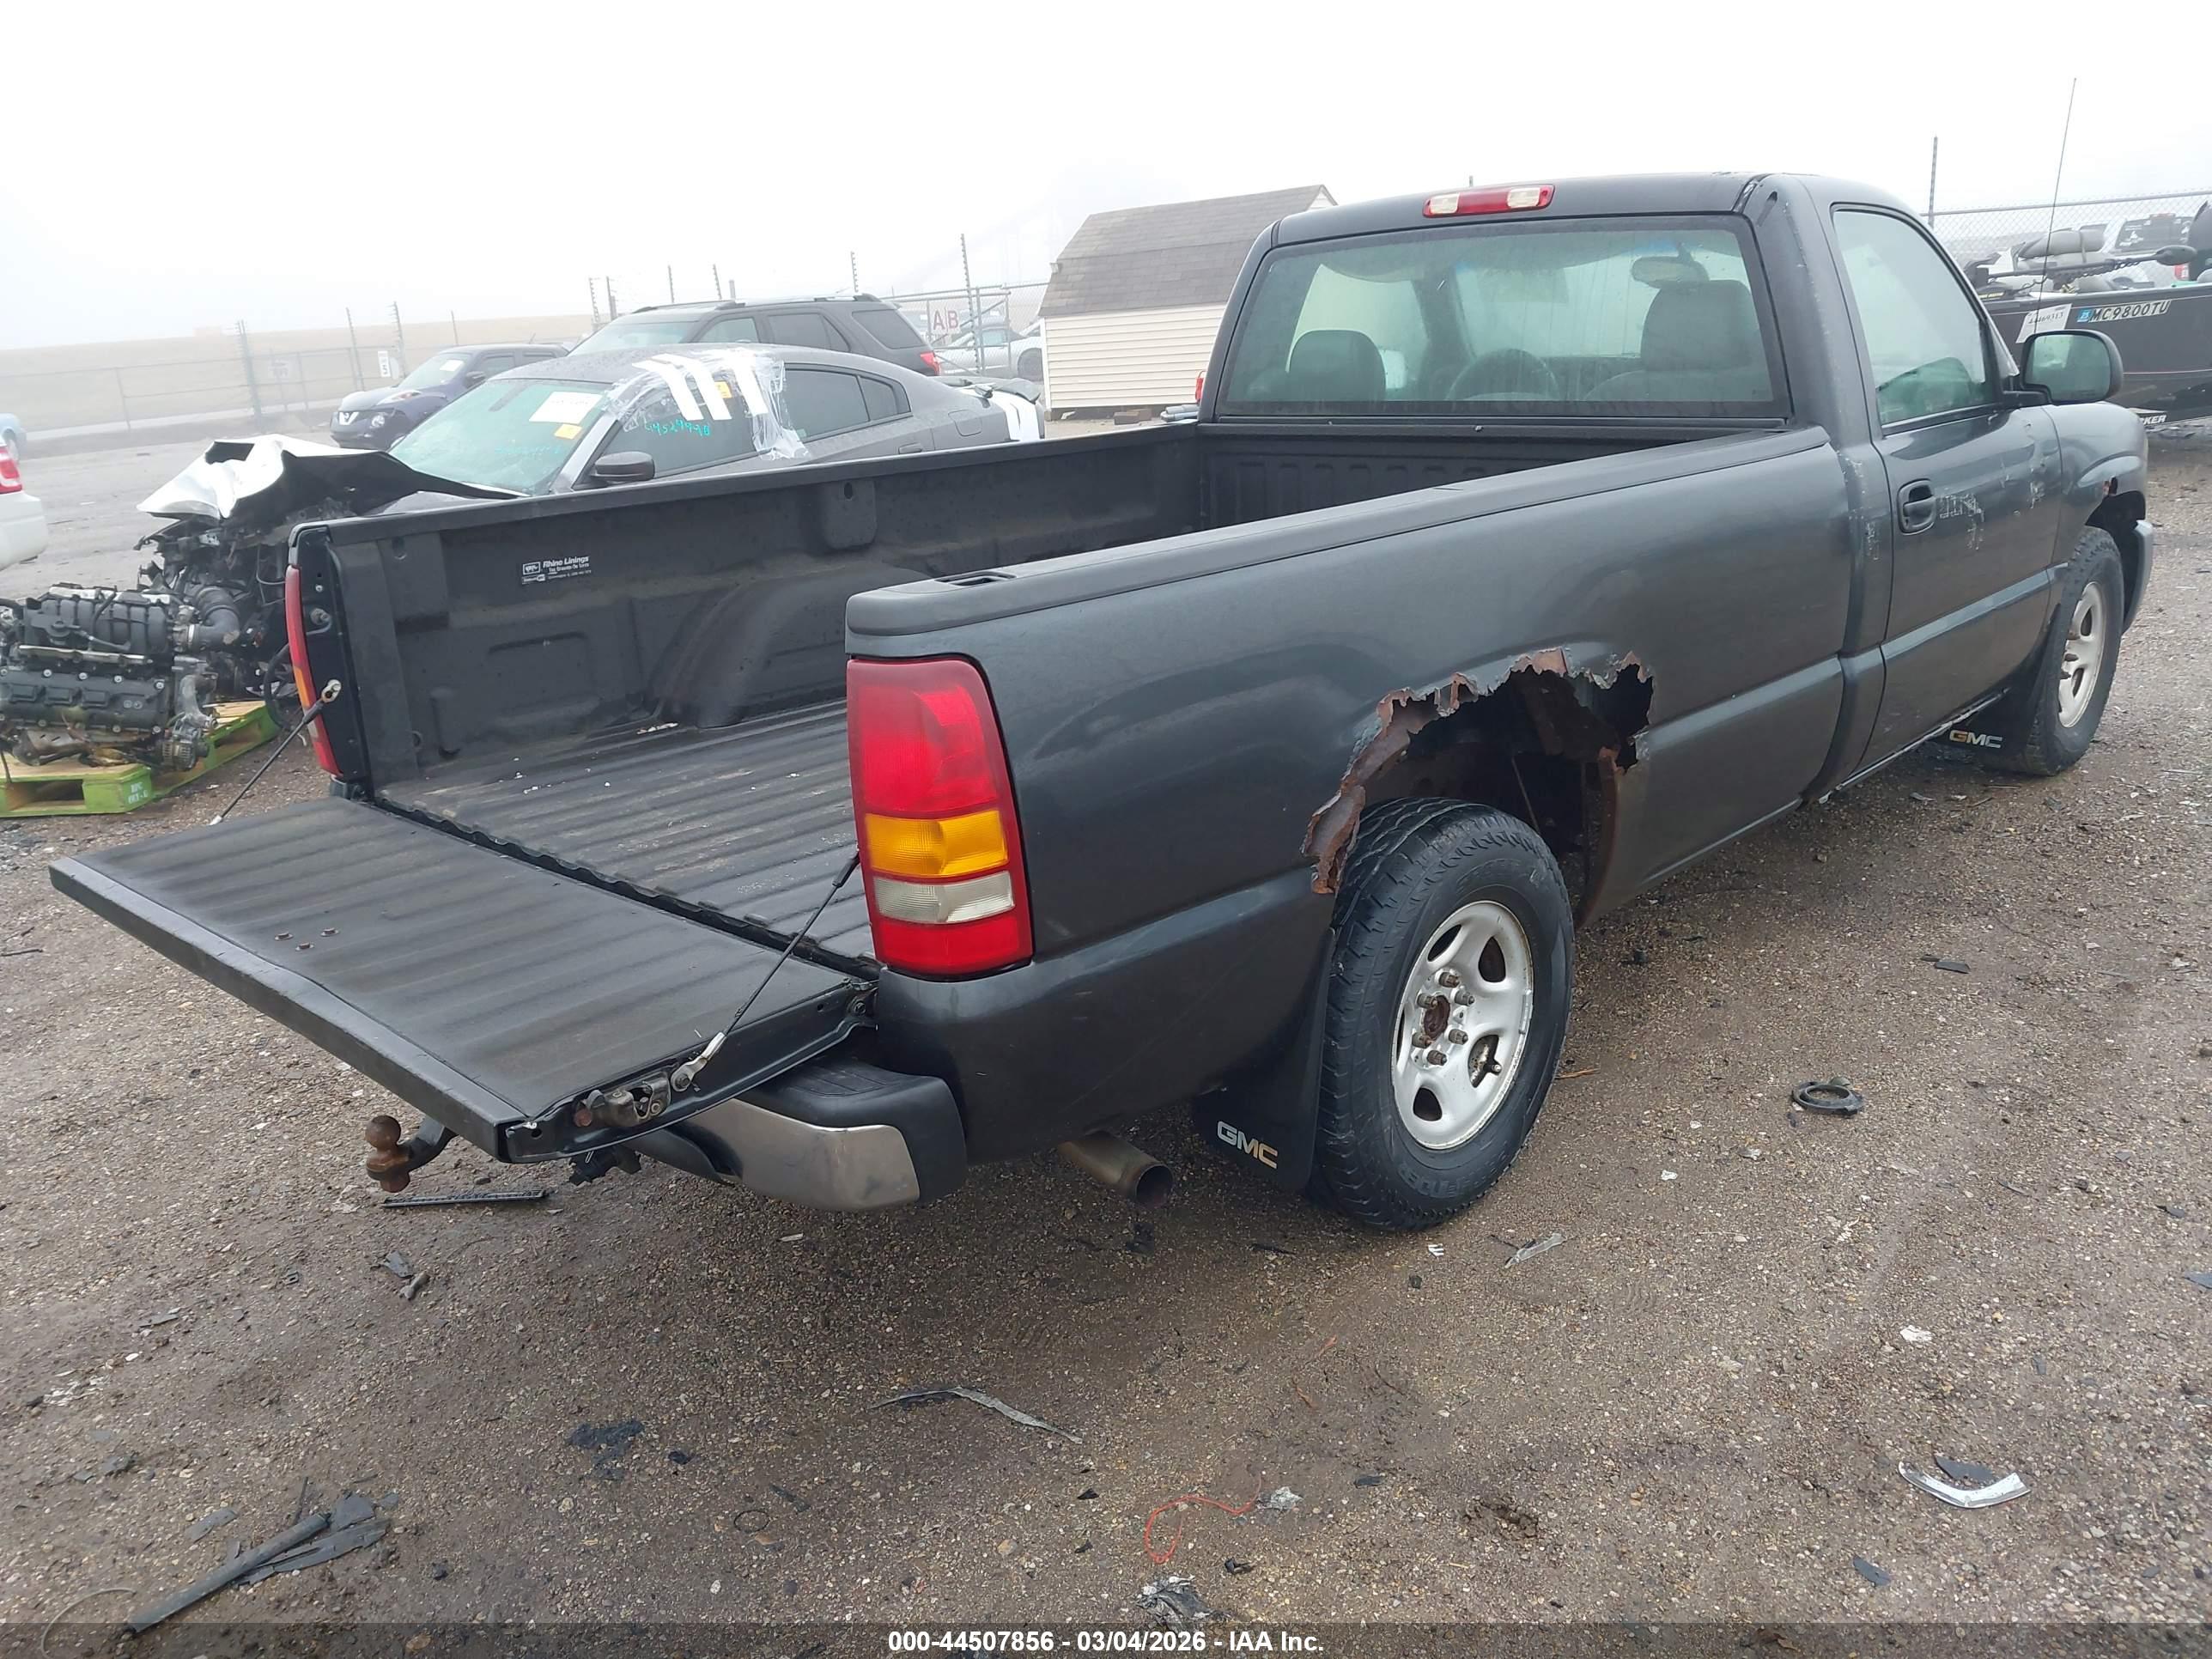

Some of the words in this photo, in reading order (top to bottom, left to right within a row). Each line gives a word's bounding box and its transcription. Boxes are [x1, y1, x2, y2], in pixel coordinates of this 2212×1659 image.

[2088, 301, 2171, 321] MC9800TU
[543, 560, 563, 568] Rhino
[1950, 730, 2002, 748] GMC
[1218, 1121, 1278, 1169] GMC
